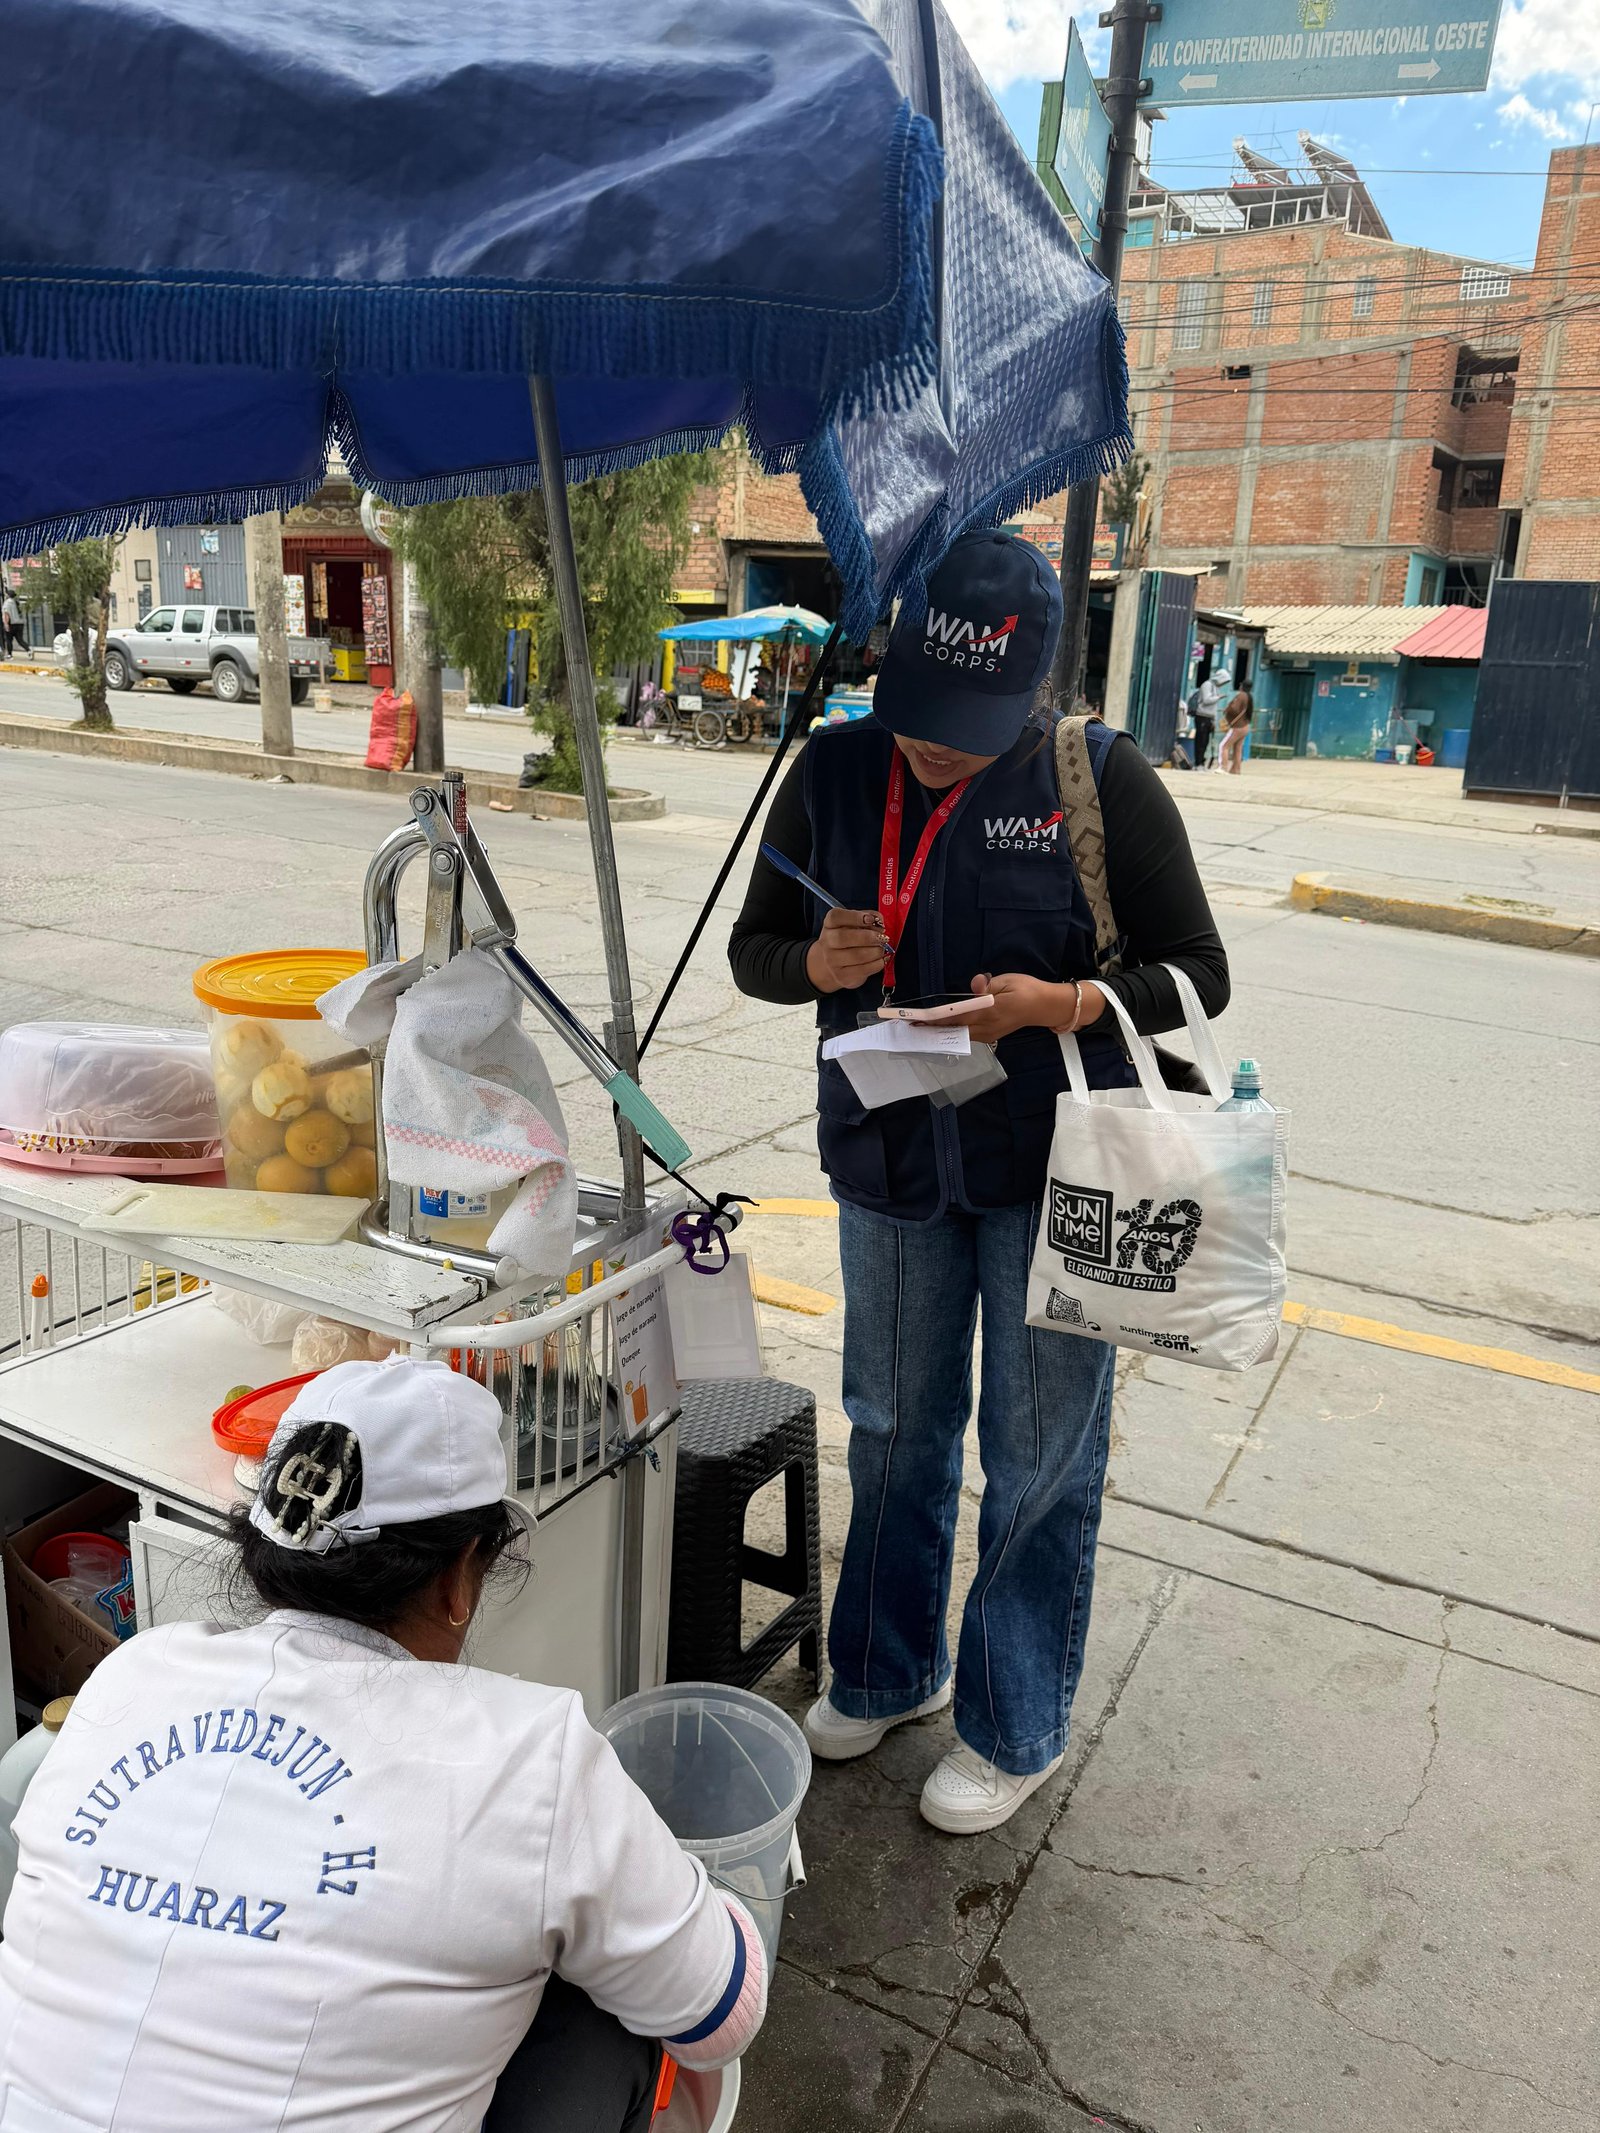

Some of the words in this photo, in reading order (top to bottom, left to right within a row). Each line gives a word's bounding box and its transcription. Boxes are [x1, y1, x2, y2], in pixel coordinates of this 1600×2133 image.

[1148, 43, 1169, 68] AV.
[1173, 34, 1304, 66] CONFRATERNIDAD
[1305, 26, 1430, 59] INTERNACIONAL
[1434, 20, 1489, 51] OESTE
[926, 606, 1010, 656] WAM
[983, 816, 1059, 840] WAM
[886, 857, 894, 890] noticias
[906, 857, 923, 890] noticias
[1054, 1192, 1101, 1224] SUN
[1054, 1232, 1101, 1253] STORE
[1125, 1227, 1171, 1244] AÑOS
[1066, 1259, 1115, 1283] ELEVANDO
[1117, 1274, 1132, 1286] TU
[1132, 1276, 1172, 1291] ESTILO
[628, 1305, 636, 1315] de
[636, 1291, 655, 1310] naranja
[631, 1326, 639, 1336] de
[638, 1312, 657, 1331] naranja
[1119, 1324, 1190, 1342] suntimestore
[1149, 1338, 1190, 1351] .com
[621, 1348, 641, 1368] Queque
[87, 1864, 287, 1942] HUARAZ
